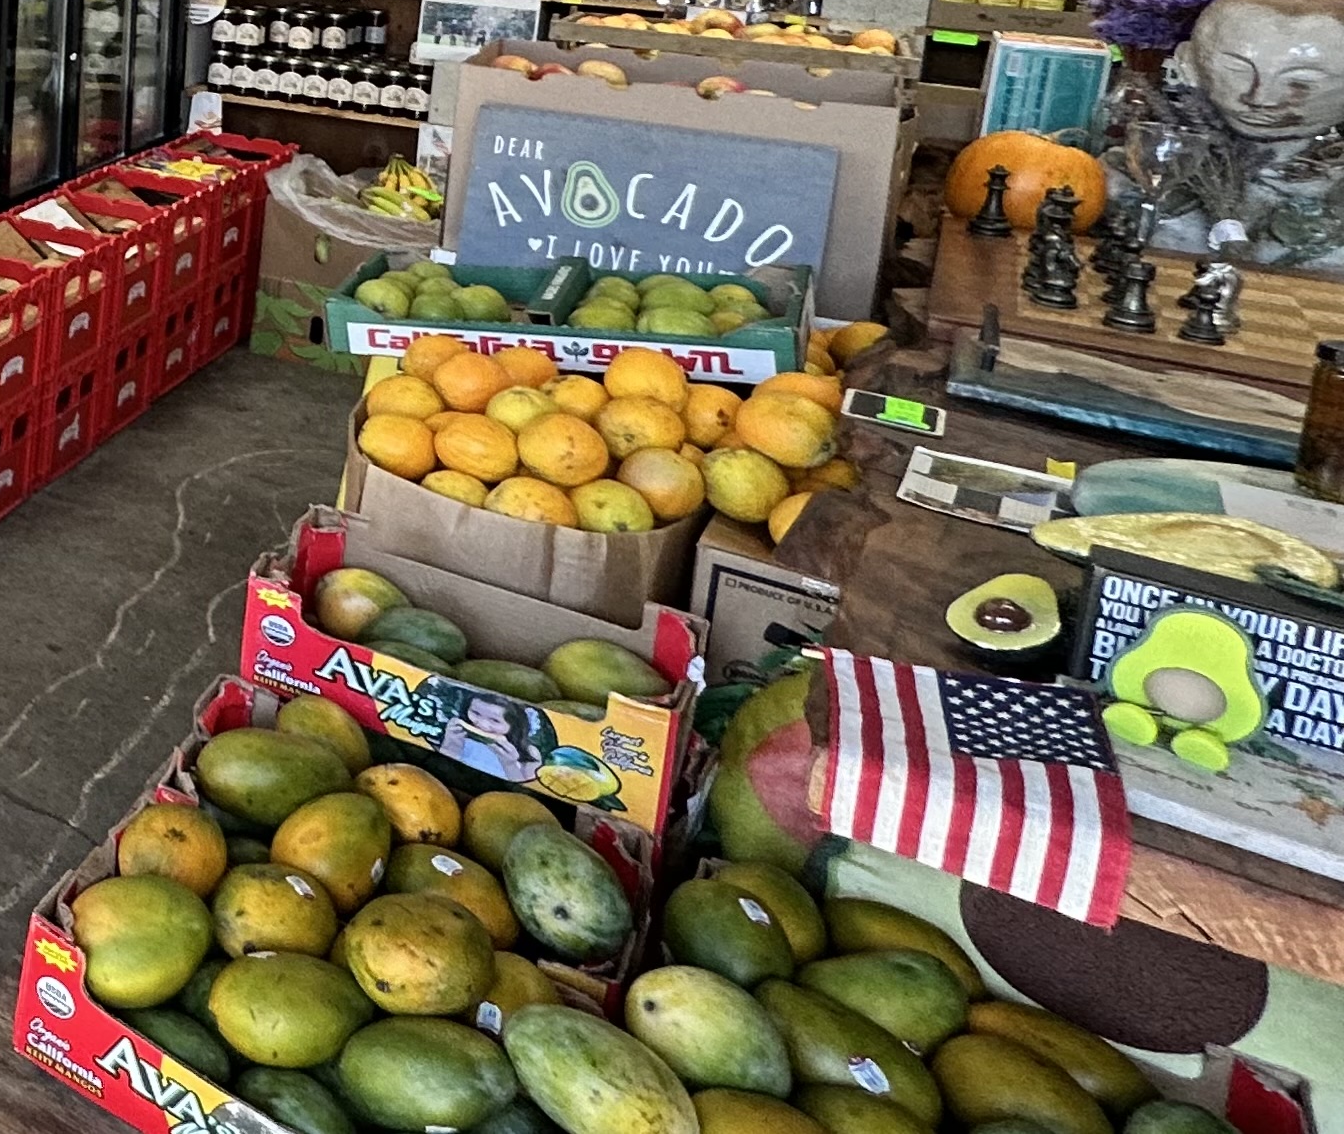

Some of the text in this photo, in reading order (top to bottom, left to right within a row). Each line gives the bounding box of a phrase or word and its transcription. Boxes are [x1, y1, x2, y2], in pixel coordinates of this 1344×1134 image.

[494, 135, 544, 160] DEAR
[546, 235, 559, 260] I
[573, 239, 642, 272] LOVE
[738, 581, 785, 602] PRODUCE
[1100, 598, 1141, 623] YOU
[1103, 575, 1180, 608] ONCE
[1221, 603, 1299, 646] YOUR
[1304, 626, 1344, 659] LIF
[267, 619, 289, 634] USDA
[1258, 640, 1272, 659] A
[253, 664, 321, 696] California
[1266, 708, 1286, 733] A
[45, 981, 67, 1002] USDA
[29, 1017, 71, 1052] Organic
[26, 1032, 103, 1090] California
[55, 1065, 105, 1099] MANGOS
